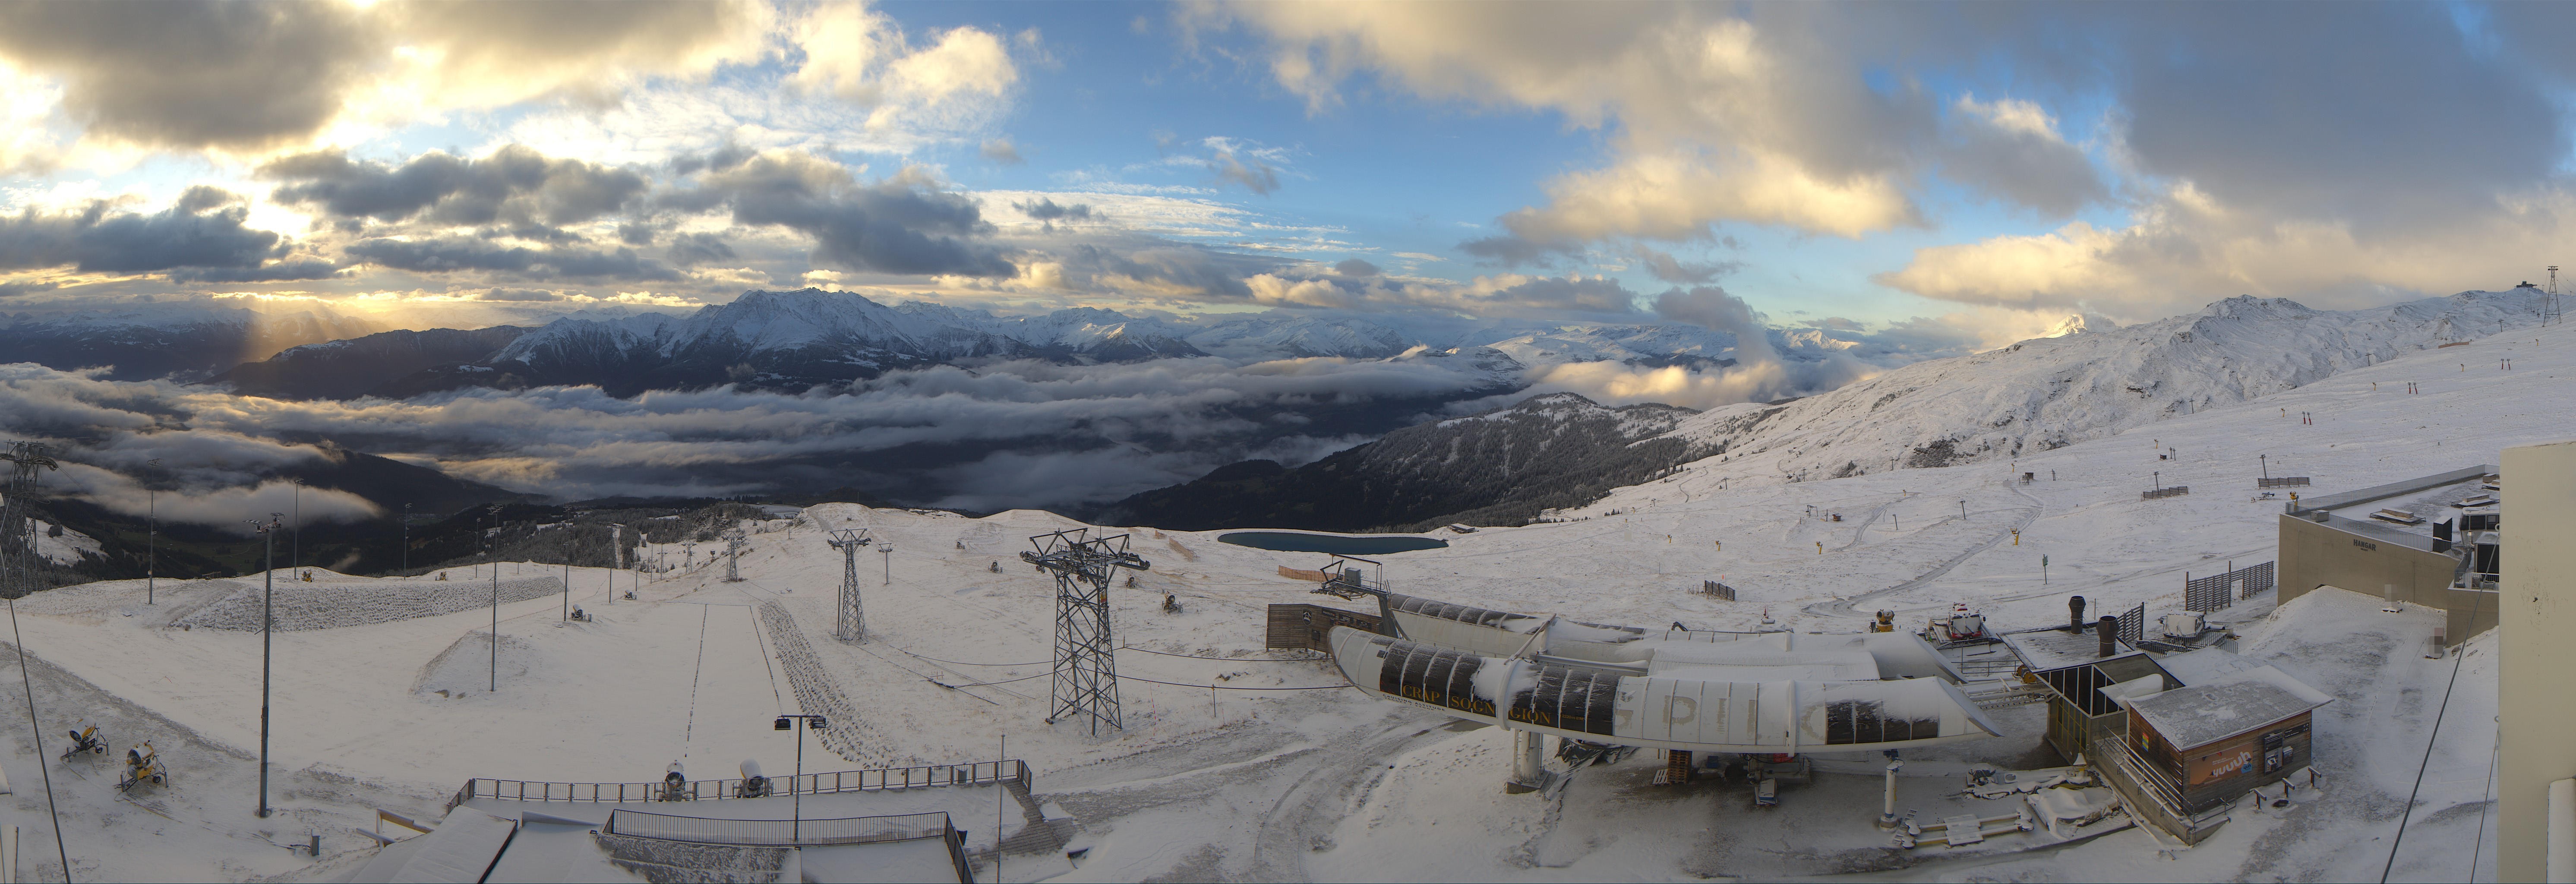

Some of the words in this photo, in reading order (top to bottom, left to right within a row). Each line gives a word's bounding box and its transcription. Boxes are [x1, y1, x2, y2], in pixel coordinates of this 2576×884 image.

[2353, 539, 2376, 551] HANGAR
[1383, 694, 1412, 704] CRUISING
[1415, 702, 1446, 711] ALTITUDE
[1403, 685, 1440, 702] CRAP
[1451, 695, 1495, 714] SOGN
[1510, 707, 1550, 724] GION
